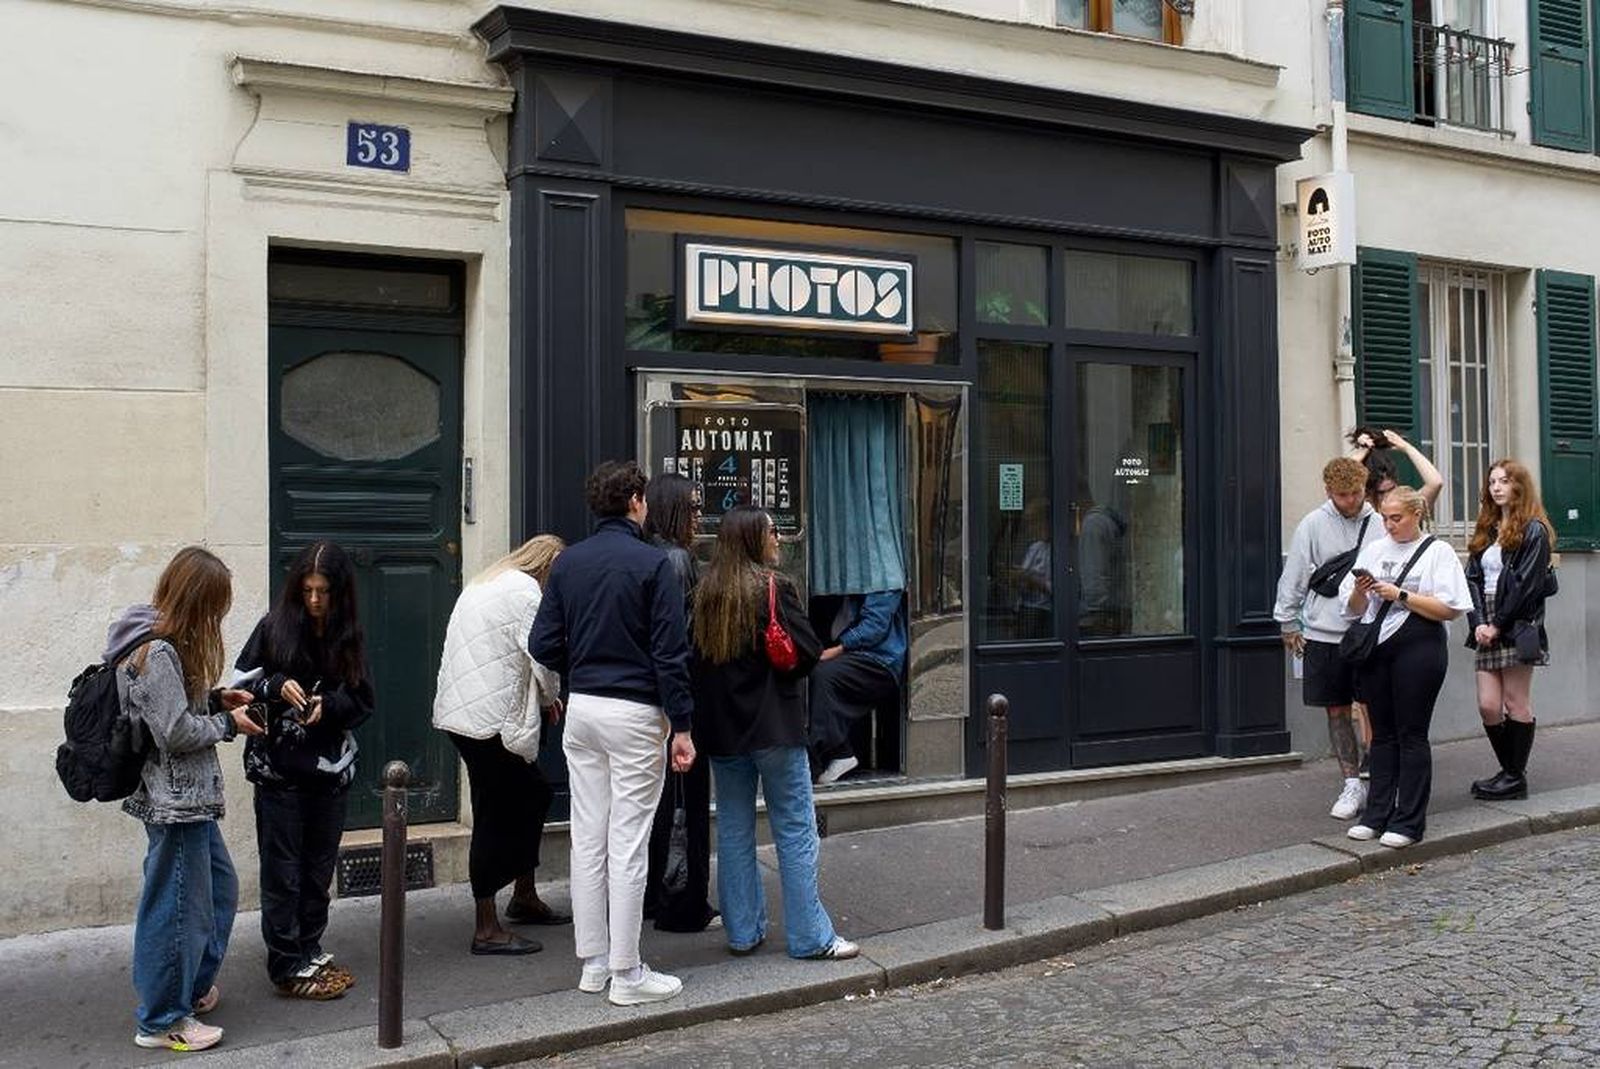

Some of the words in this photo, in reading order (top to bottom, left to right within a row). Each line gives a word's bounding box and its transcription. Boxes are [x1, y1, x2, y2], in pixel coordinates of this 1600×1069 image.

[358, 129, 399, 165] 53
[1307, 227, 1330, 238] FOTO
[1308, 236, 1330, 247] AUTO
[703, 258, 902, 318] PHOTOS
[704, 416, 749, 427] FOTO
[680, 429, 773, 452] AUTOMAT
[718, 456, 737, 474] 4
[1122, 458, 1142, 466] FOTO
[1114, 468, 1149, 476] AUTOMAT
